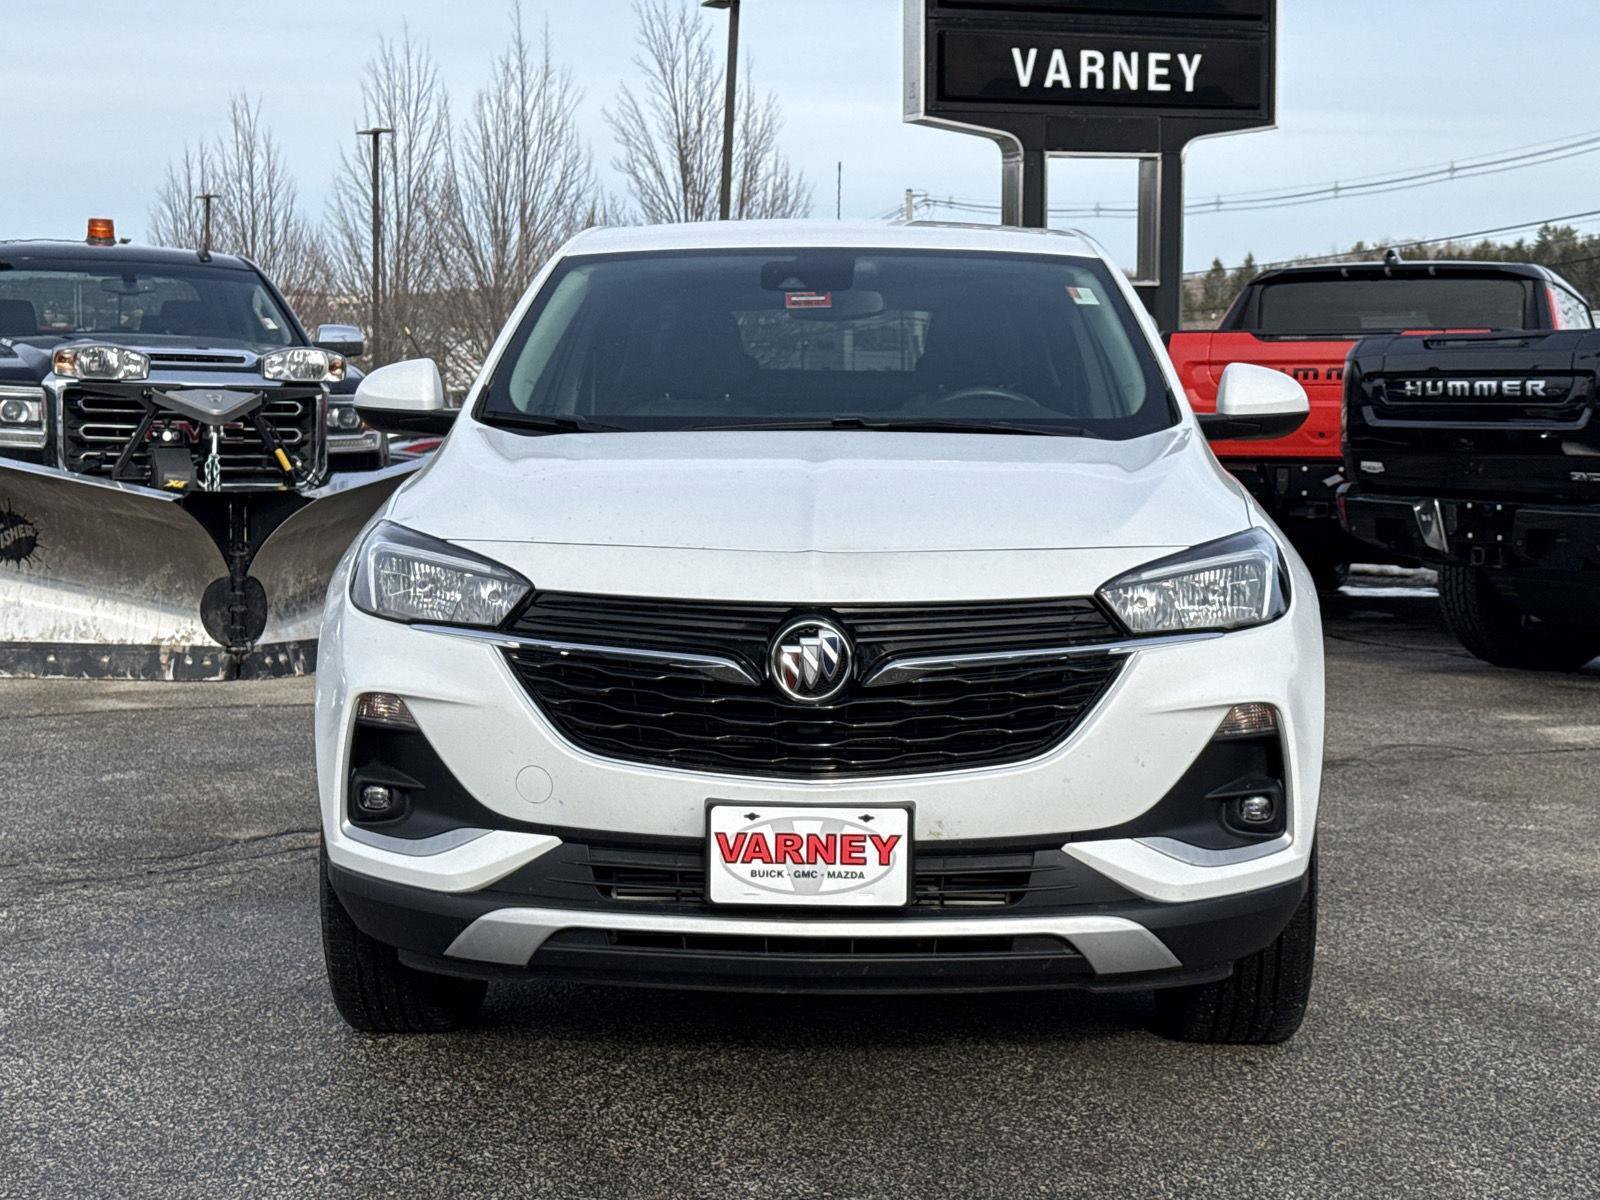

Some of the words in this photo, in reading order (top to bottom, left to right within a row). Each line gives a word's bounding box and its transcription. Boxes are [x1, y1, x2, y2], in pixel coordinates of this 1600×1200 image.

[1011, 47, 1203, 92] VARNEY
[1404, 379, 1547, 397] HUMMER
[0, 522, 36, 549] ISHER
[714, 831, 903, 867] VARNEY
[750, 869, 784, 879] BUICK
[793, 869, 818, 879] GMC
[827, 870, 866, 880] MAZDA
